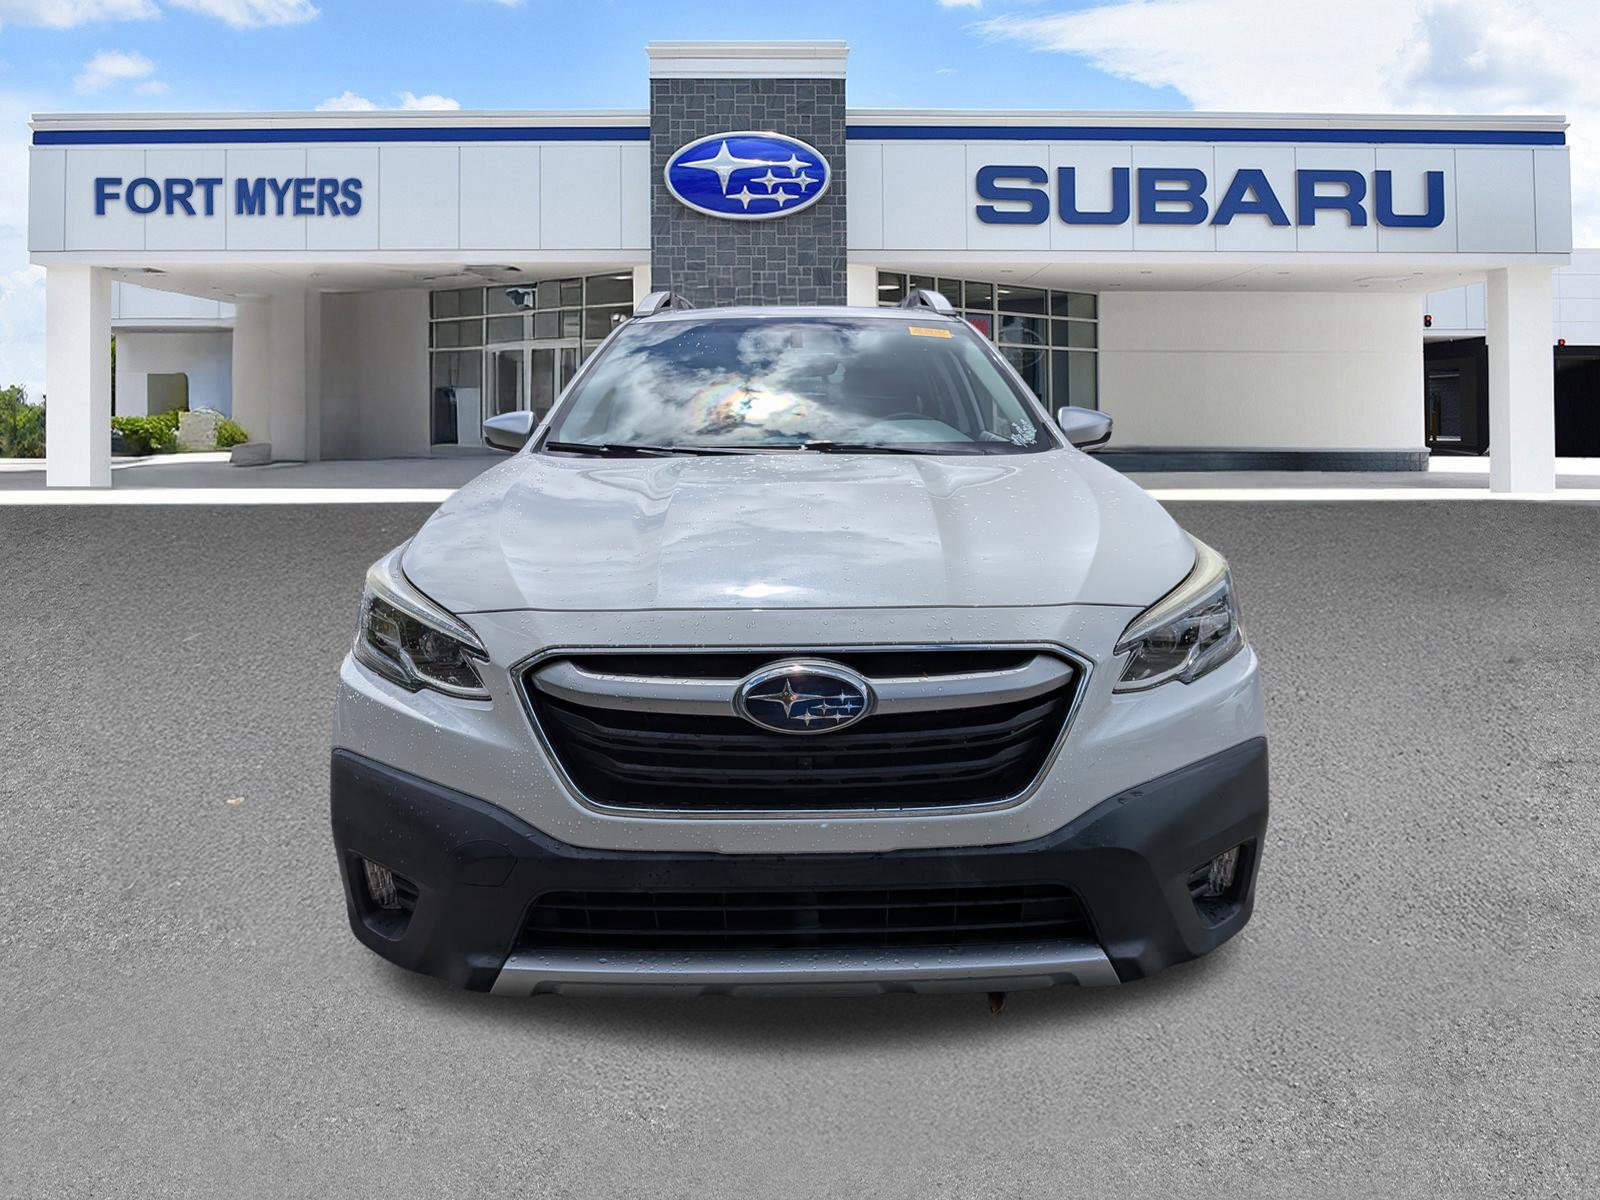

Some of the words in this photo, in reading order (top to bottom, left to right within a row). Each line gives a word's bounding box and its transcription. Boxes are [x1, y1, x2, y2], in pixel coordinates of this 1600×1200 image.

[94, 177, 223, 216] FORT
[235, 177, 363, 217] MYERS
[975, 165, 1445, 229] SUBARU
